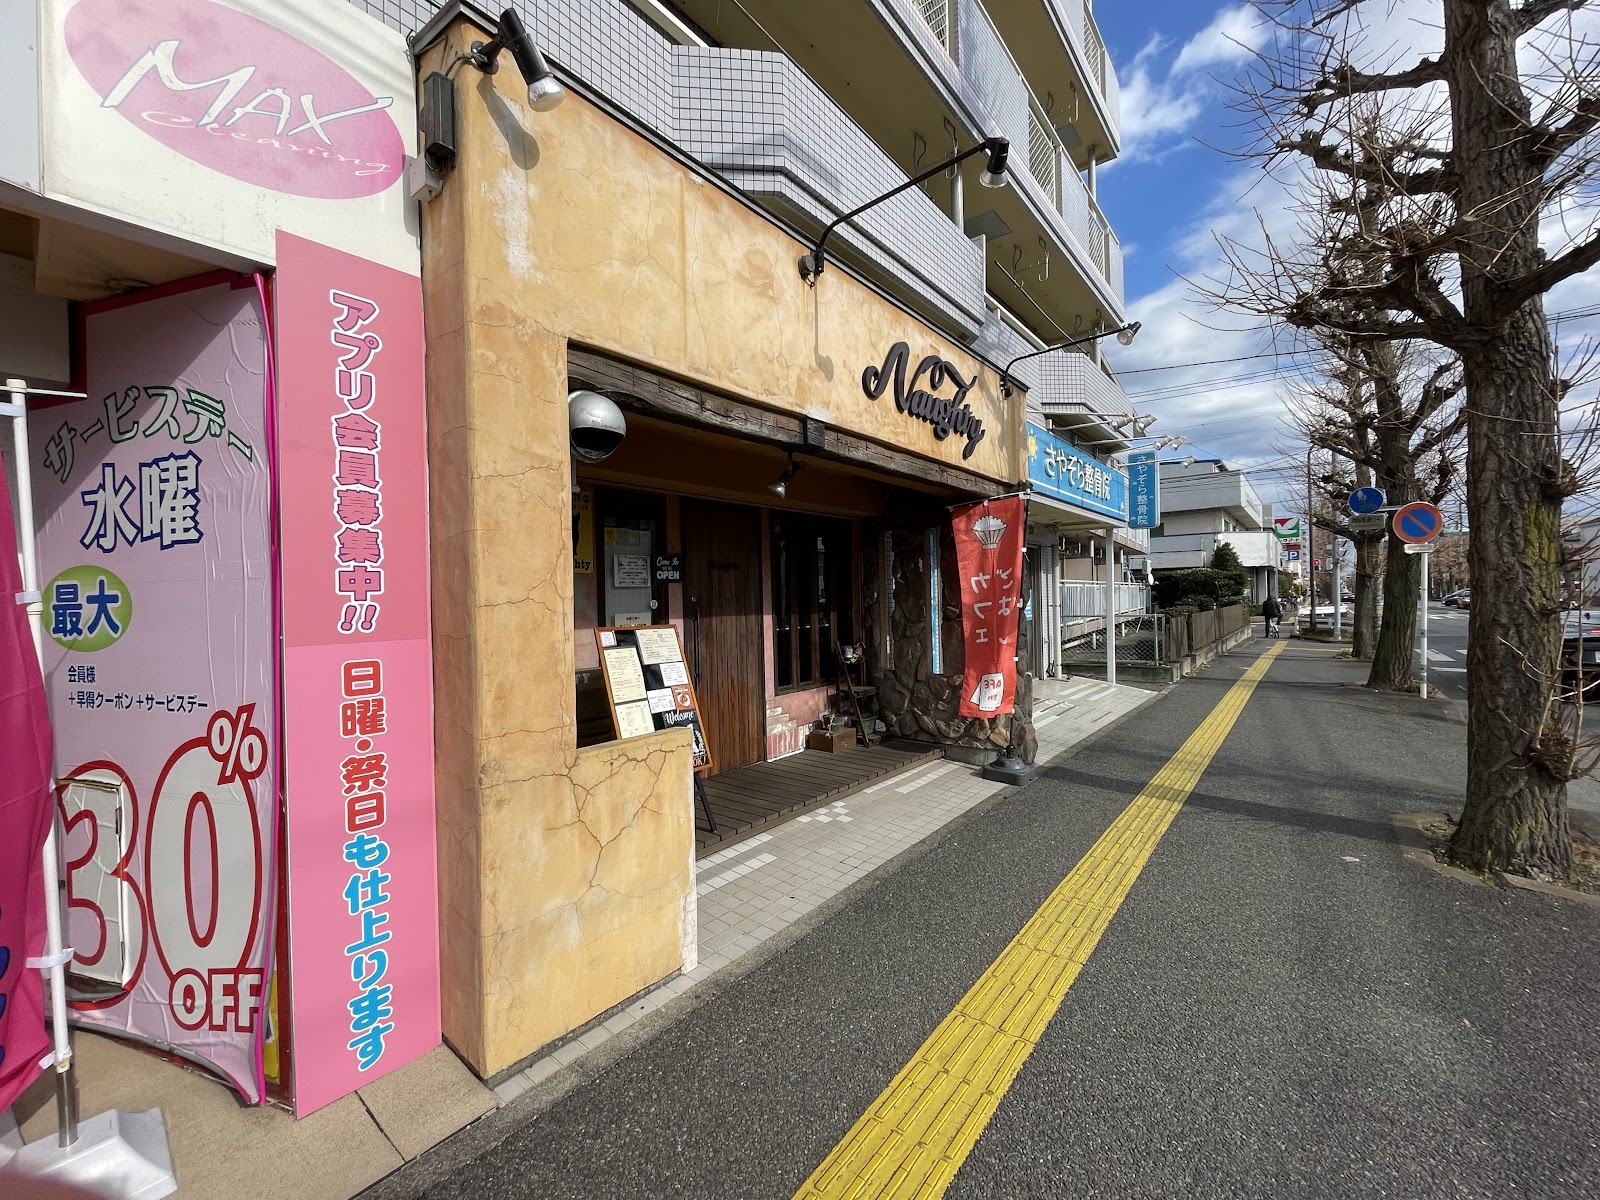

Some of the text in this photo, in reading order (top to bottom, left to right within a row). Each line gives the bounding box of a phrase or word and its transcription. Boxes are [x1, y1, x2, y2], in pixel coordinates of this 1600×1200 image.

[101, 39, 394, 146] MAX
[862, 341, 986, 461] Naughty
[43, 385, 254, 483] サービスデー
[80, 450, 205, 554] 水曜
[1044, 443, 1112, 502] さやそら整骨院
[1136, 454, 1149, 526] さやそら整骨院
[656, 570, 680, 580] OPEN
[1289, 552, 1298, 560] P
[51, 579, 123, 640] 最大
[67, 665, 96, 684] 会員様
[664, 708, 695, 724] Welcome
[340, 660, 396, 1073] 日曜・祭日も仕上ります
[170, 967, 264, 1032] OFF
